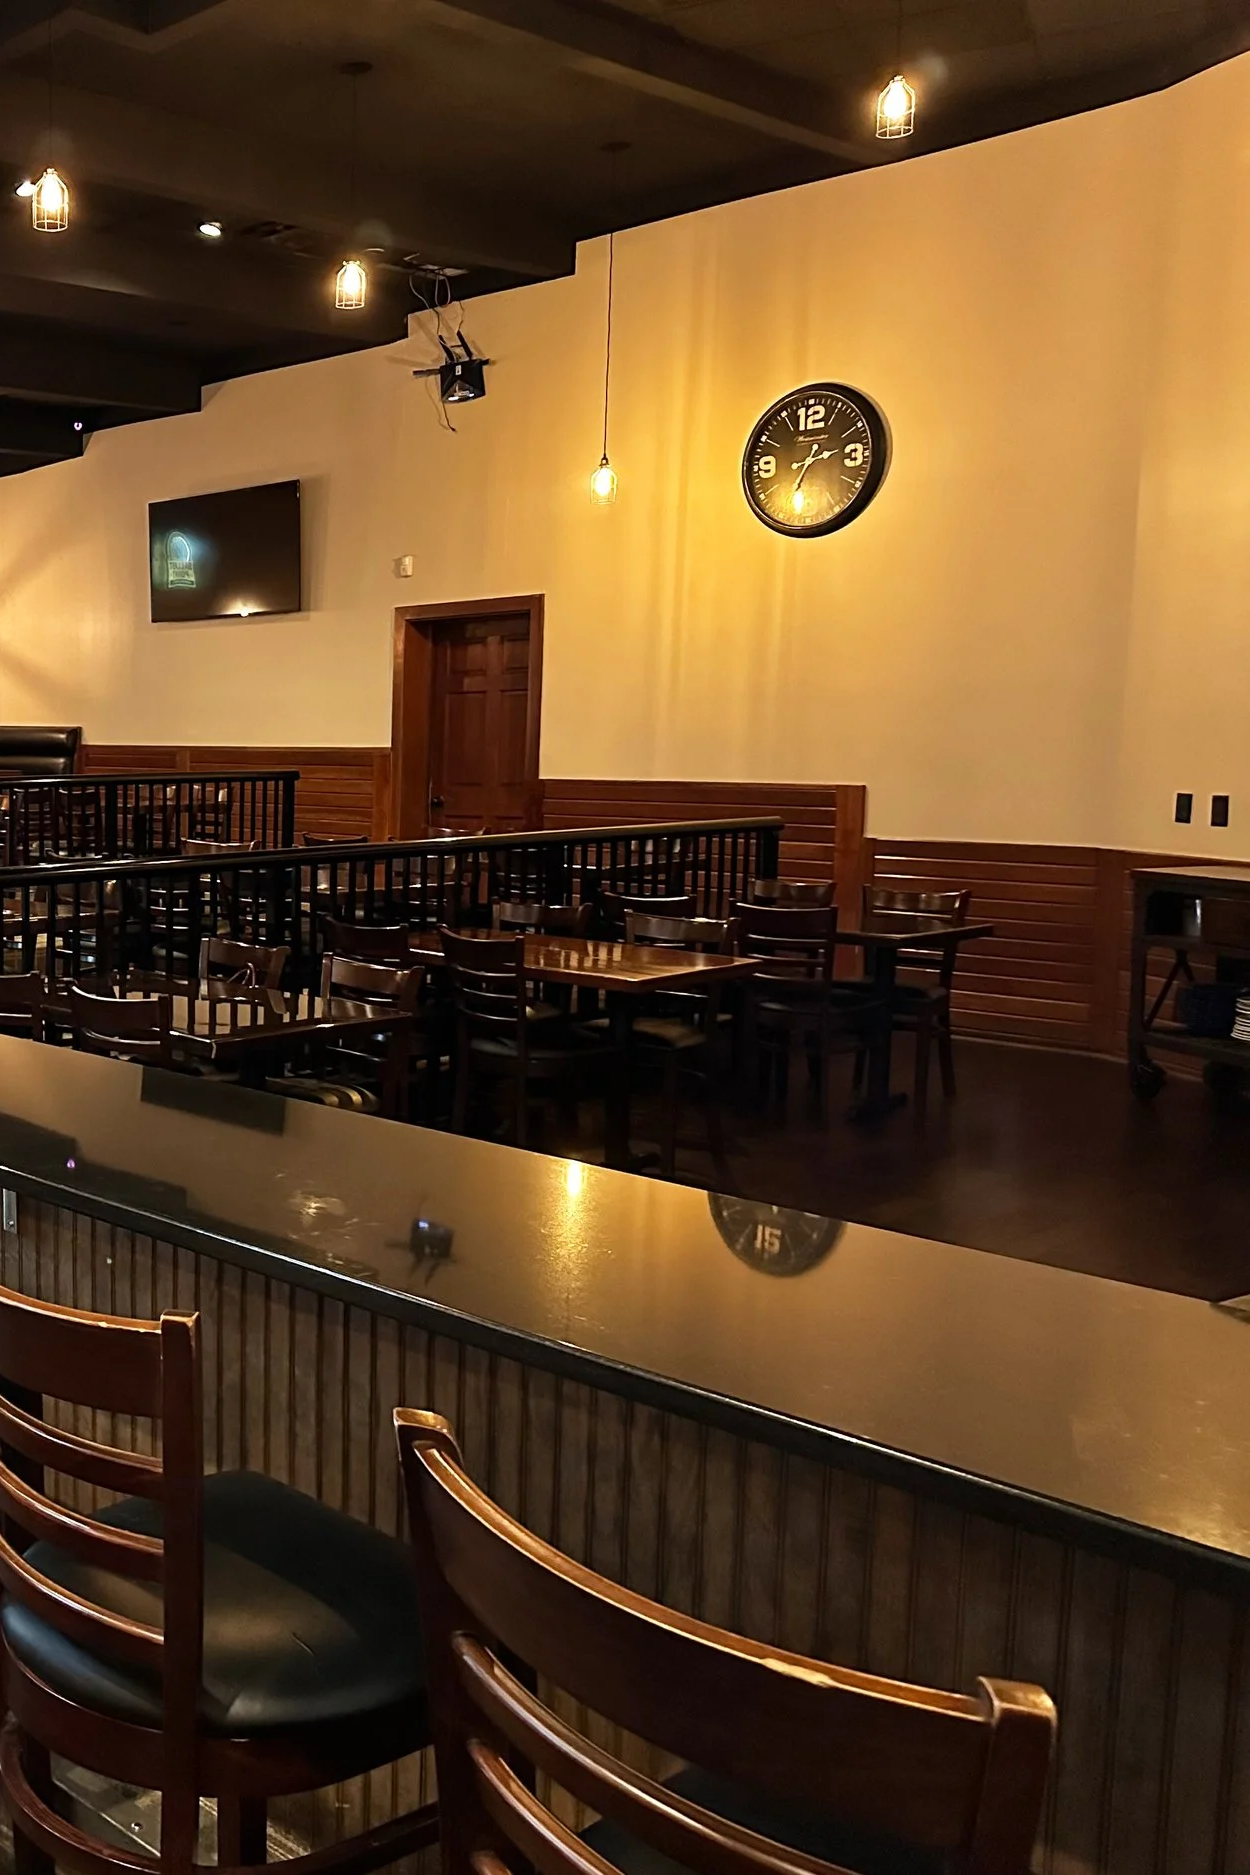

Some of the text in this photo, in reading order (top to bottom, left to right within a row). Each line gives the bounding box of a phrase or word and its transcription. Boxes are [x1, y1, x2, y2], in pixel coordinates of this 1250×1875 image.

[797, 405, 825, 431] 12
[758, 455, 777, 478] 9
[844, 443, 864, 467] 3
